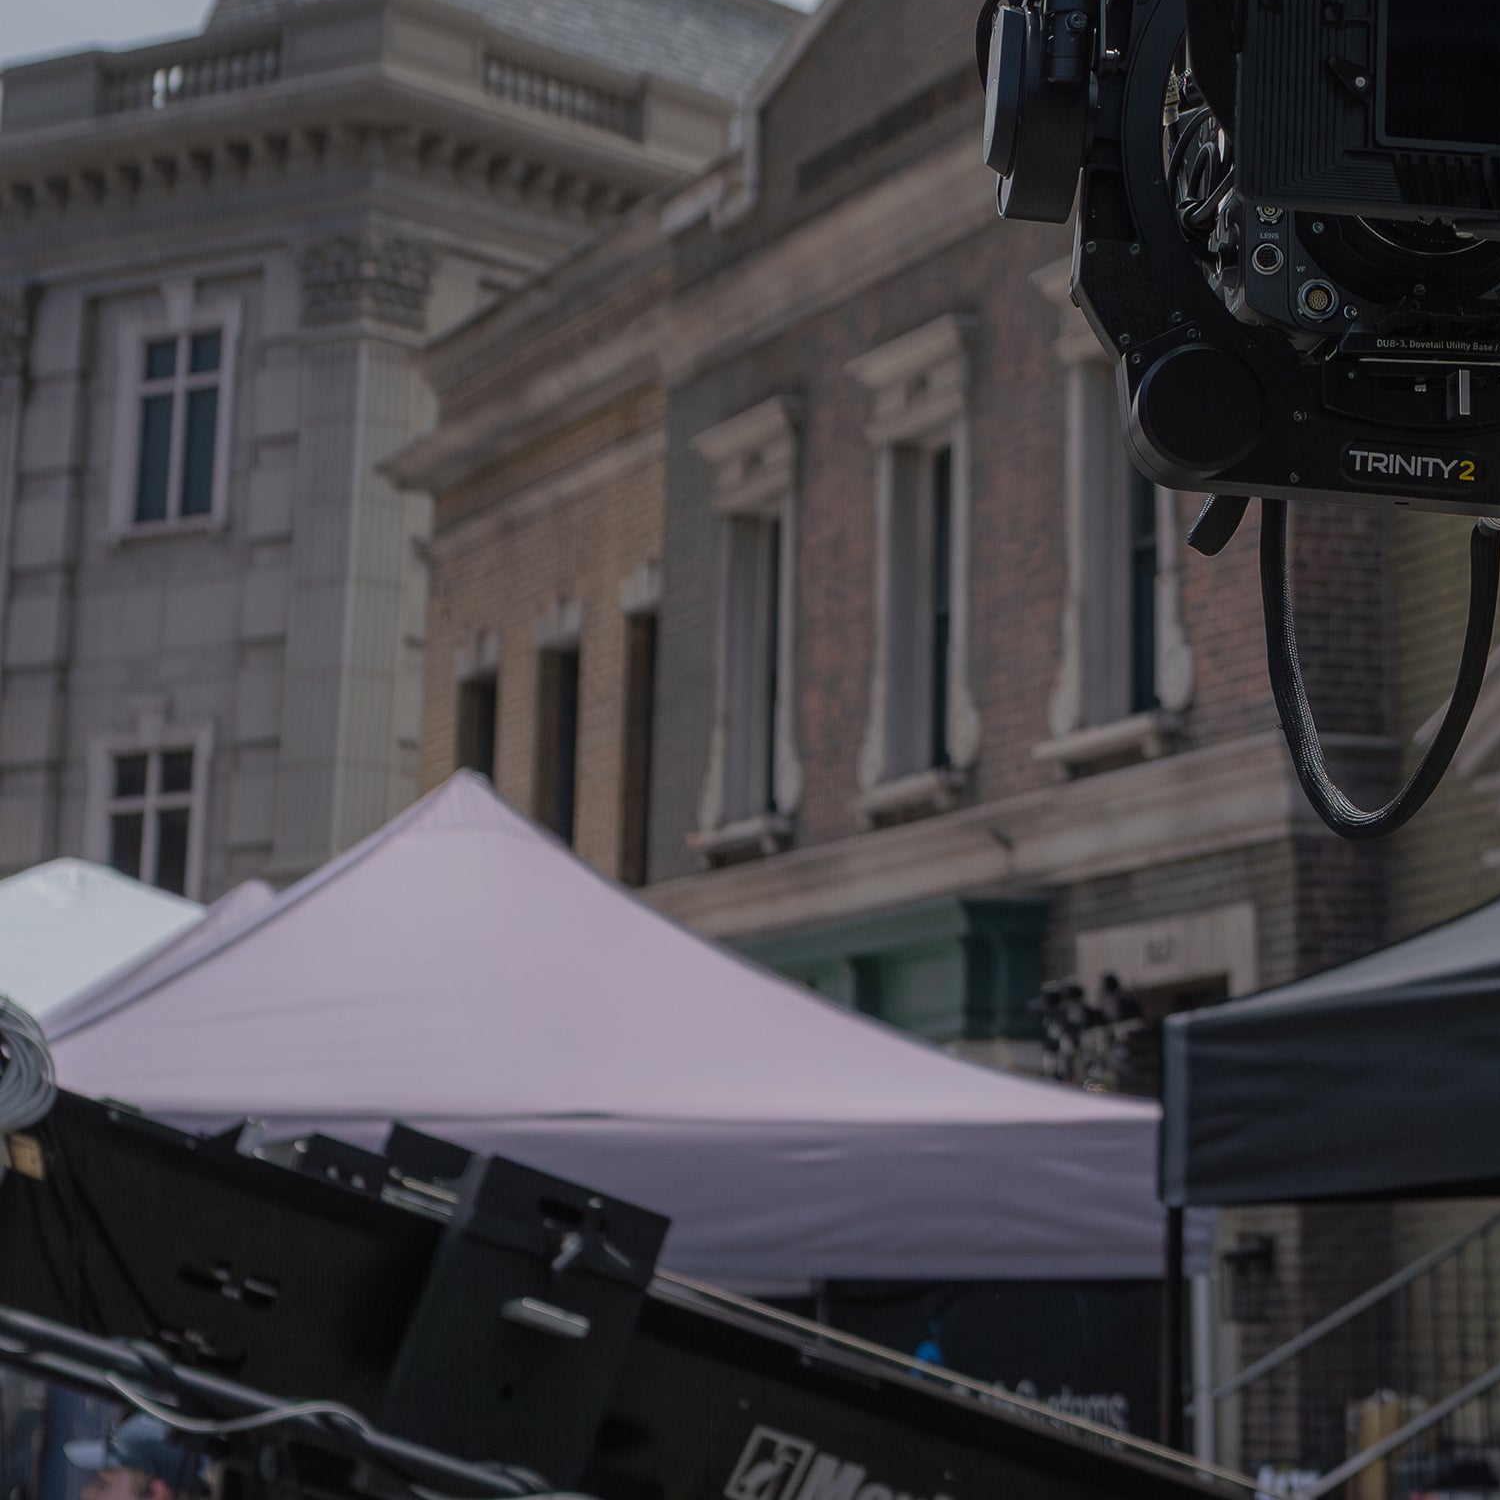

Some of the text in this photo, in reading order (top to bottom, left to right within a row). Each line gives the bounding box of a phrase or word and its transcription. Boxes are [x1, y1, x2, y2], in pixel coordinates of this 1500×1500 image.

[1259, 232, 1279, 240] LENS
[1376, 338, 1408, 349] DUB-3,
[1409, 339, 1444, 349] Dovetail
[1446, 340, 1471, 352] Utility
[1473, 341, 1493, 352] Base
